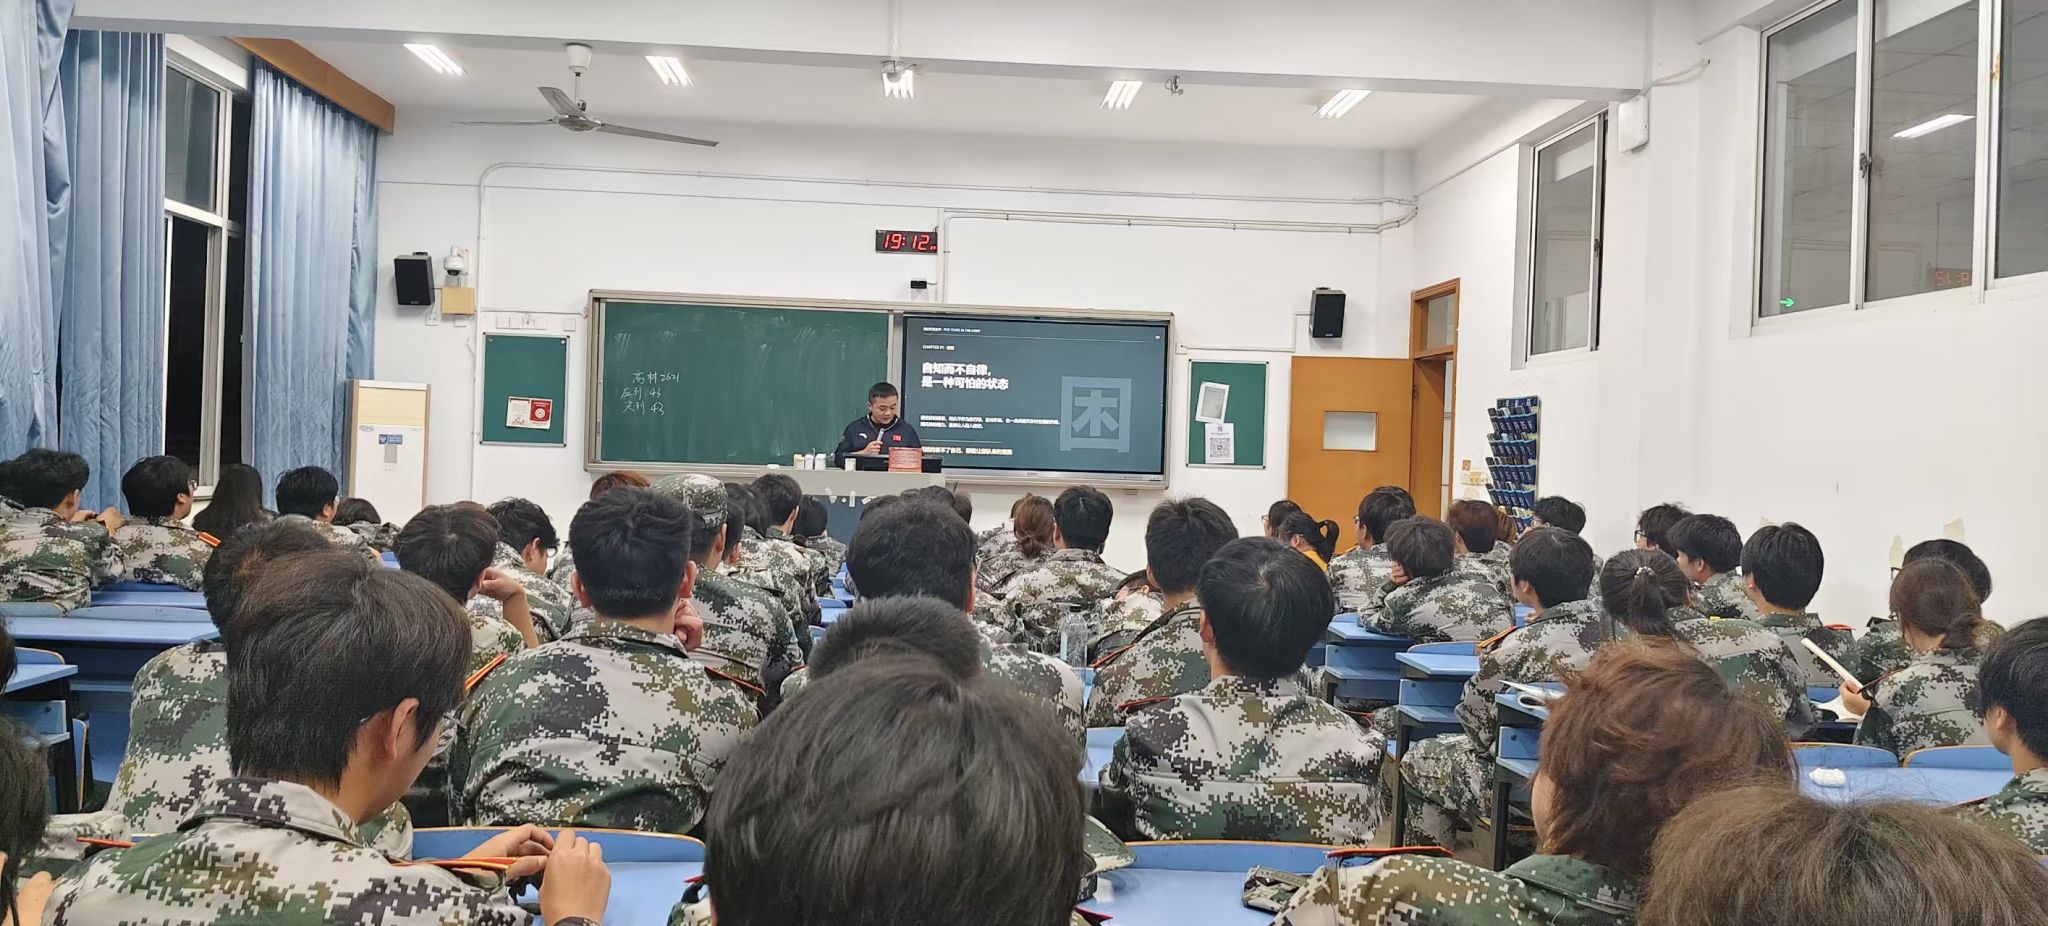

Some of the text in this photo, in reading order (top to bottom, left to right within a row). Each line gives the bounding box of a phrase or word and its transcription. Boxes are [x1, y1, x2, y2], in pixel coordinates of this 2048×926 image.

[884, 234, 930, 250] 19:12
[922, 376, 1009, 390] 是一种可怕的状态
[650, 401, 665, 416] 43
[1059, 375, 1132, 453] 困
